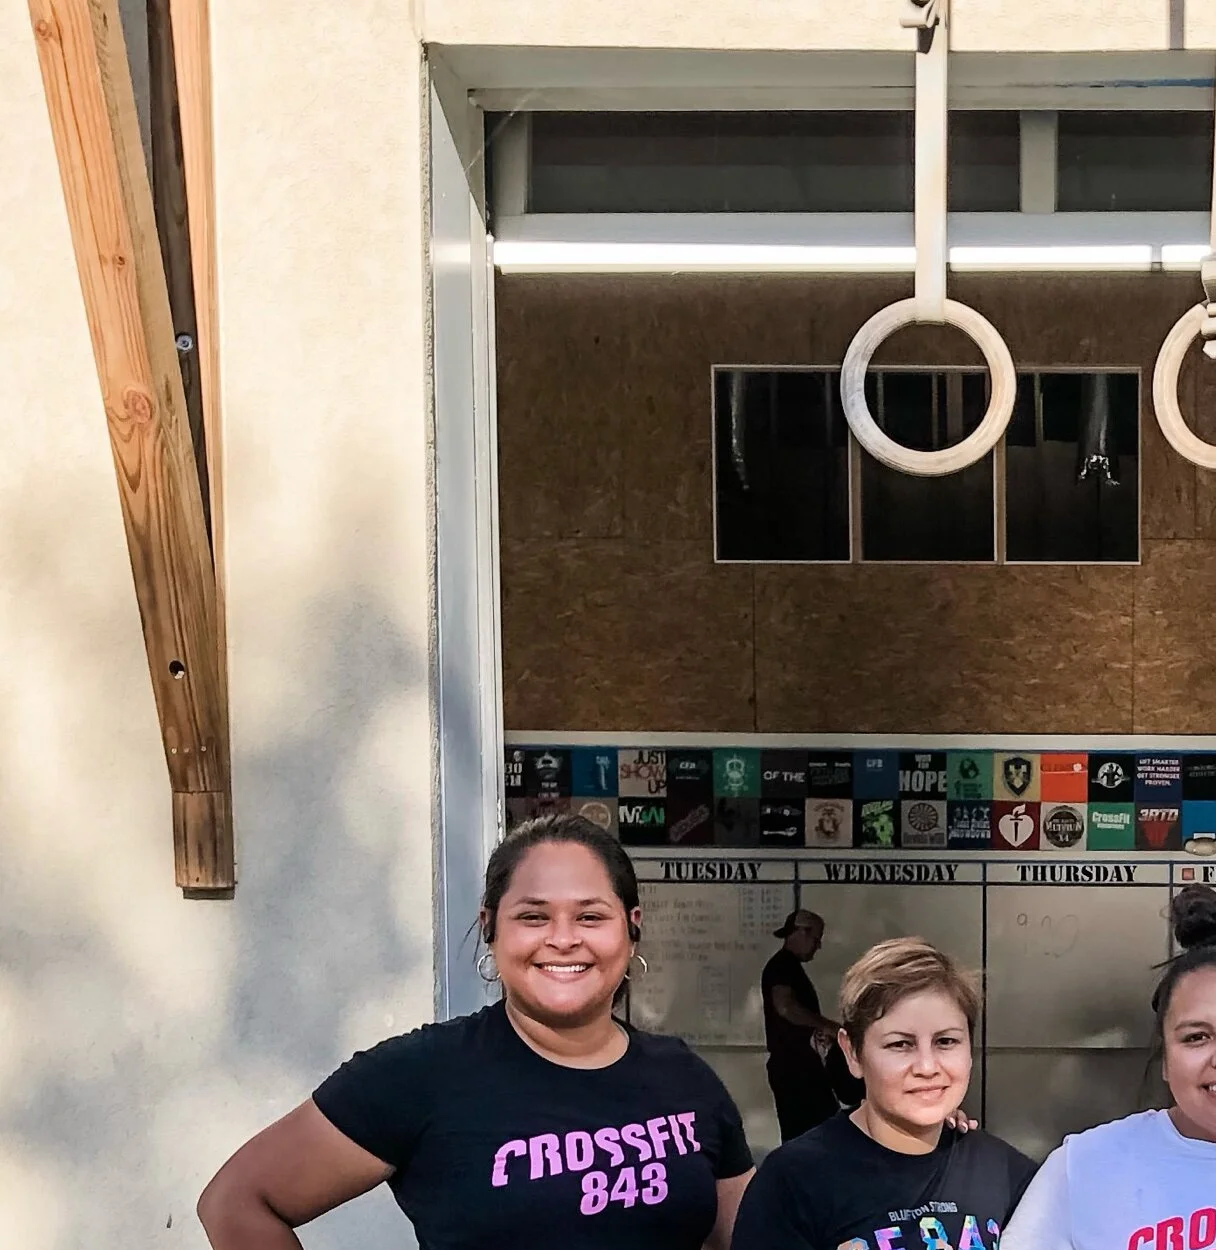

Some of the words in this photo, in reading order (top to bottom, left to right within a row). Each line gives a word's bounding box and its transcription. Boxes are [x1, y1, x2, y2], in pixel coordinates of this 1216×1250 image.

[633, 750, 665, 765] JUST
[620, 764, 666, 779] SHOW
[763, 771, 779, 781] OF
[782, 771, 806, 783] THE
[648, 779, 668, 794] UP
[899, 770, 948, 792] HOPE
[661, 863, 762, 881] TUESDAY
[825, 864, 959, 882] WEDNESDAY
[1017, 865, 1138, 882] THURSDAY
[491, 1111, 701, 1187] CROSSFIT
[580, 1162, 668, 1216] 843
